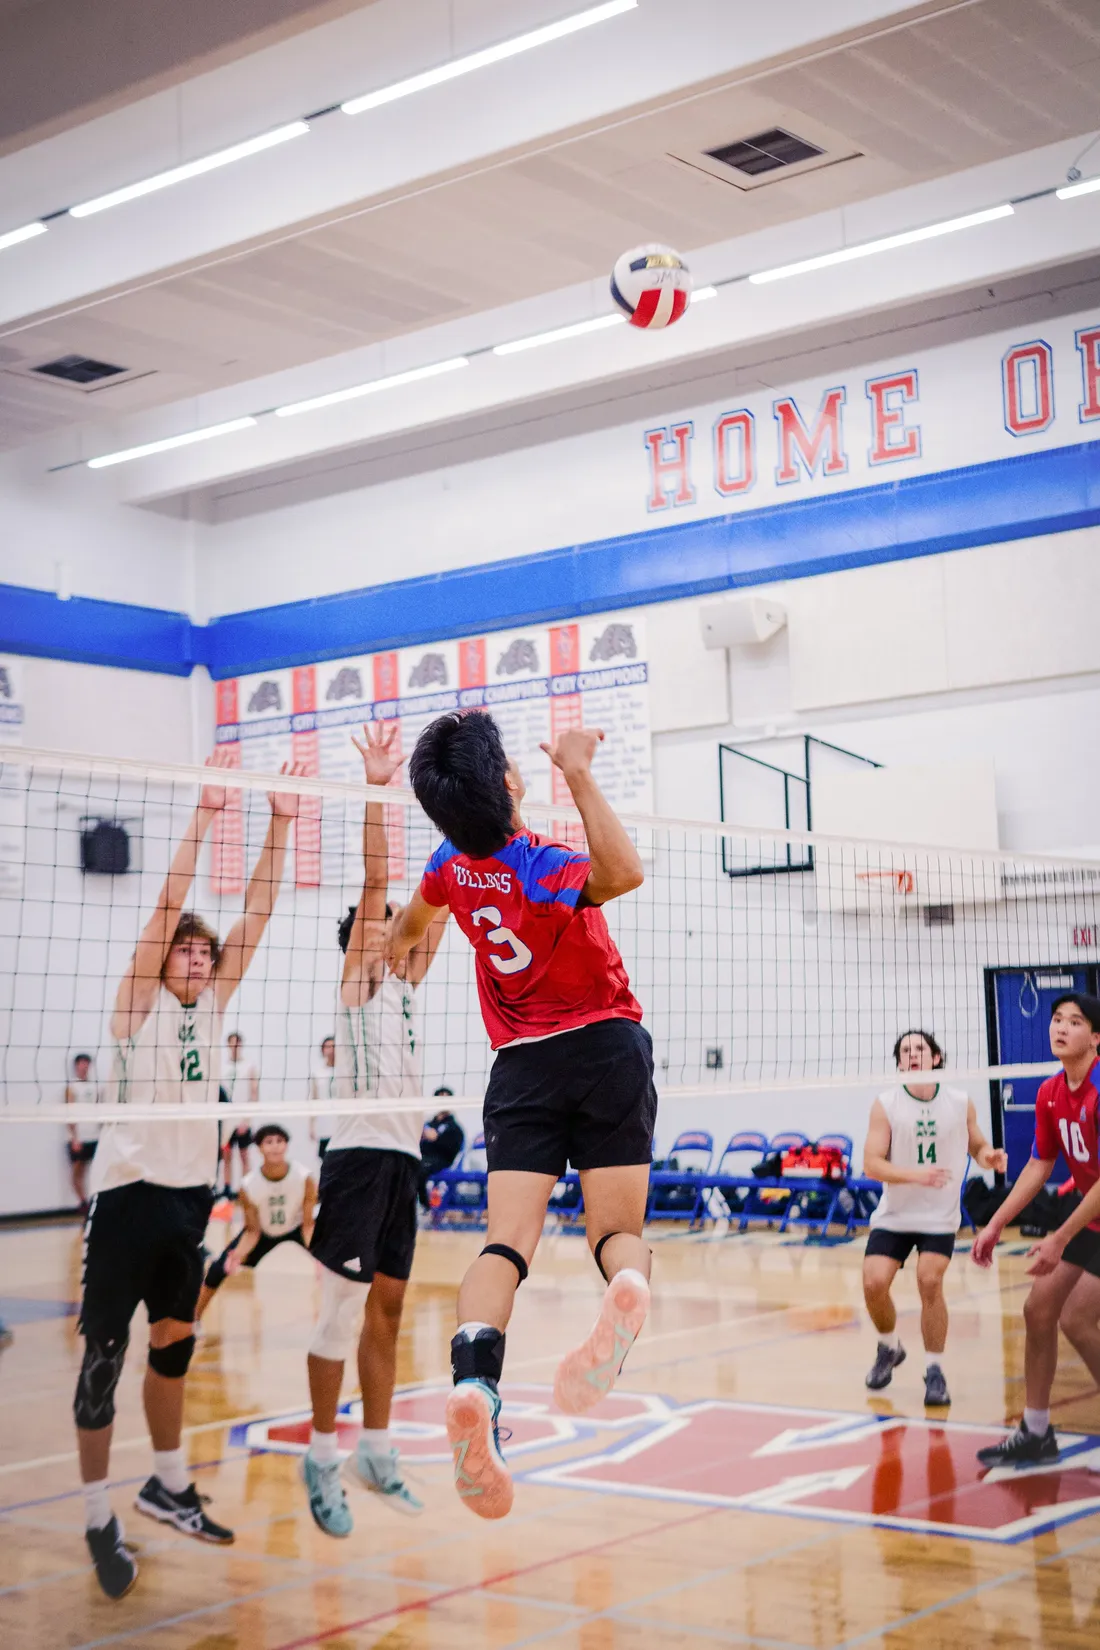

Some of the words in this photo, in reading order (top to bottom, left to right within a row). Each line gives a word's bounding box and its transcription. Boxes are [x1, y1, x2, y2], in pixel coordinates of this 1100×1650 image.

[644, 368, 922, 514] HOME
[552, 675, 577, 693] CITY
[577, 665, 646, 691] CHAMPIONS
[470, 905, 533, 975] 3
[917, 1142, 937, 1164] 14
[1059, 1117, 1090, 1163] 10
